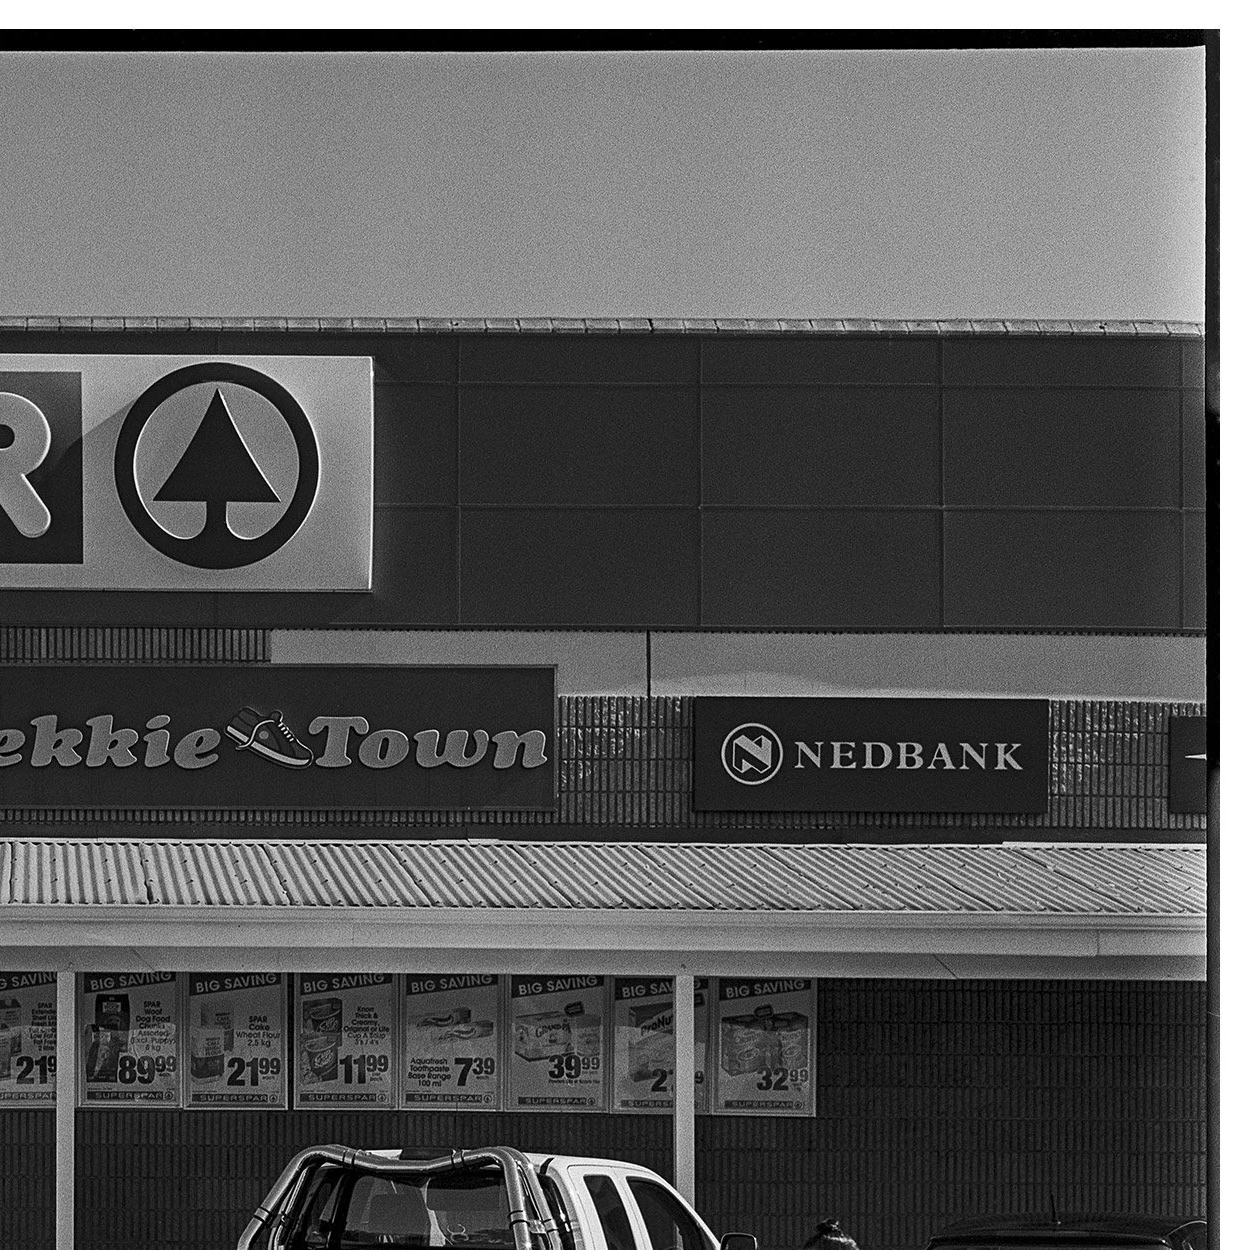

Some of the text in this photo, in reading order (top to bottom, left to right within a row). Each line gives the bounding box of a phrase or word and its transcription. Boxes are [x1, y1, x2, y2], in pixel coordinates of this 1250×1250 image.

[310, 716, 548, 769] Town
[794, 741, 1024, 770] NEDBANK
[90, 972, 172, 991] BIG SAVING
[195, 973, 277, 994] BIG SAVING
[303, 973, 385, 994] BIG SAVING
[411, 973, 493, 994] BIG SAVING
[518, 975, 598, 996] BIG SAVING
[622, 985, 646, 998] BIG
[725, 980, 805, 999] BIG SAVING
[135, 1015, 171, 1023] Dog Food
[248, 1023, 270, 1031] Cake
[235, 1031, 281, 1039] Wheat Flour
[347, 1032, 361, 1040] Cup
[261, 1039, 271, 1048] kg
[409, 1065, 450, 1073] Toothpaste
[427, 1072, 451, 1081] Range
[95, 1092, 162, 1100] SUPERSPAR
[199, 1094, 267, 1102] SUPERSPAR
[308, 1094, 376, 1102] SUPERSPAR
[414, 1094, 482, 1102] SUPERSPAR
[525, 1097, 587, 1105] SUPERSPAR
[731, 1100, 793, 1108] SUPERSPAR
